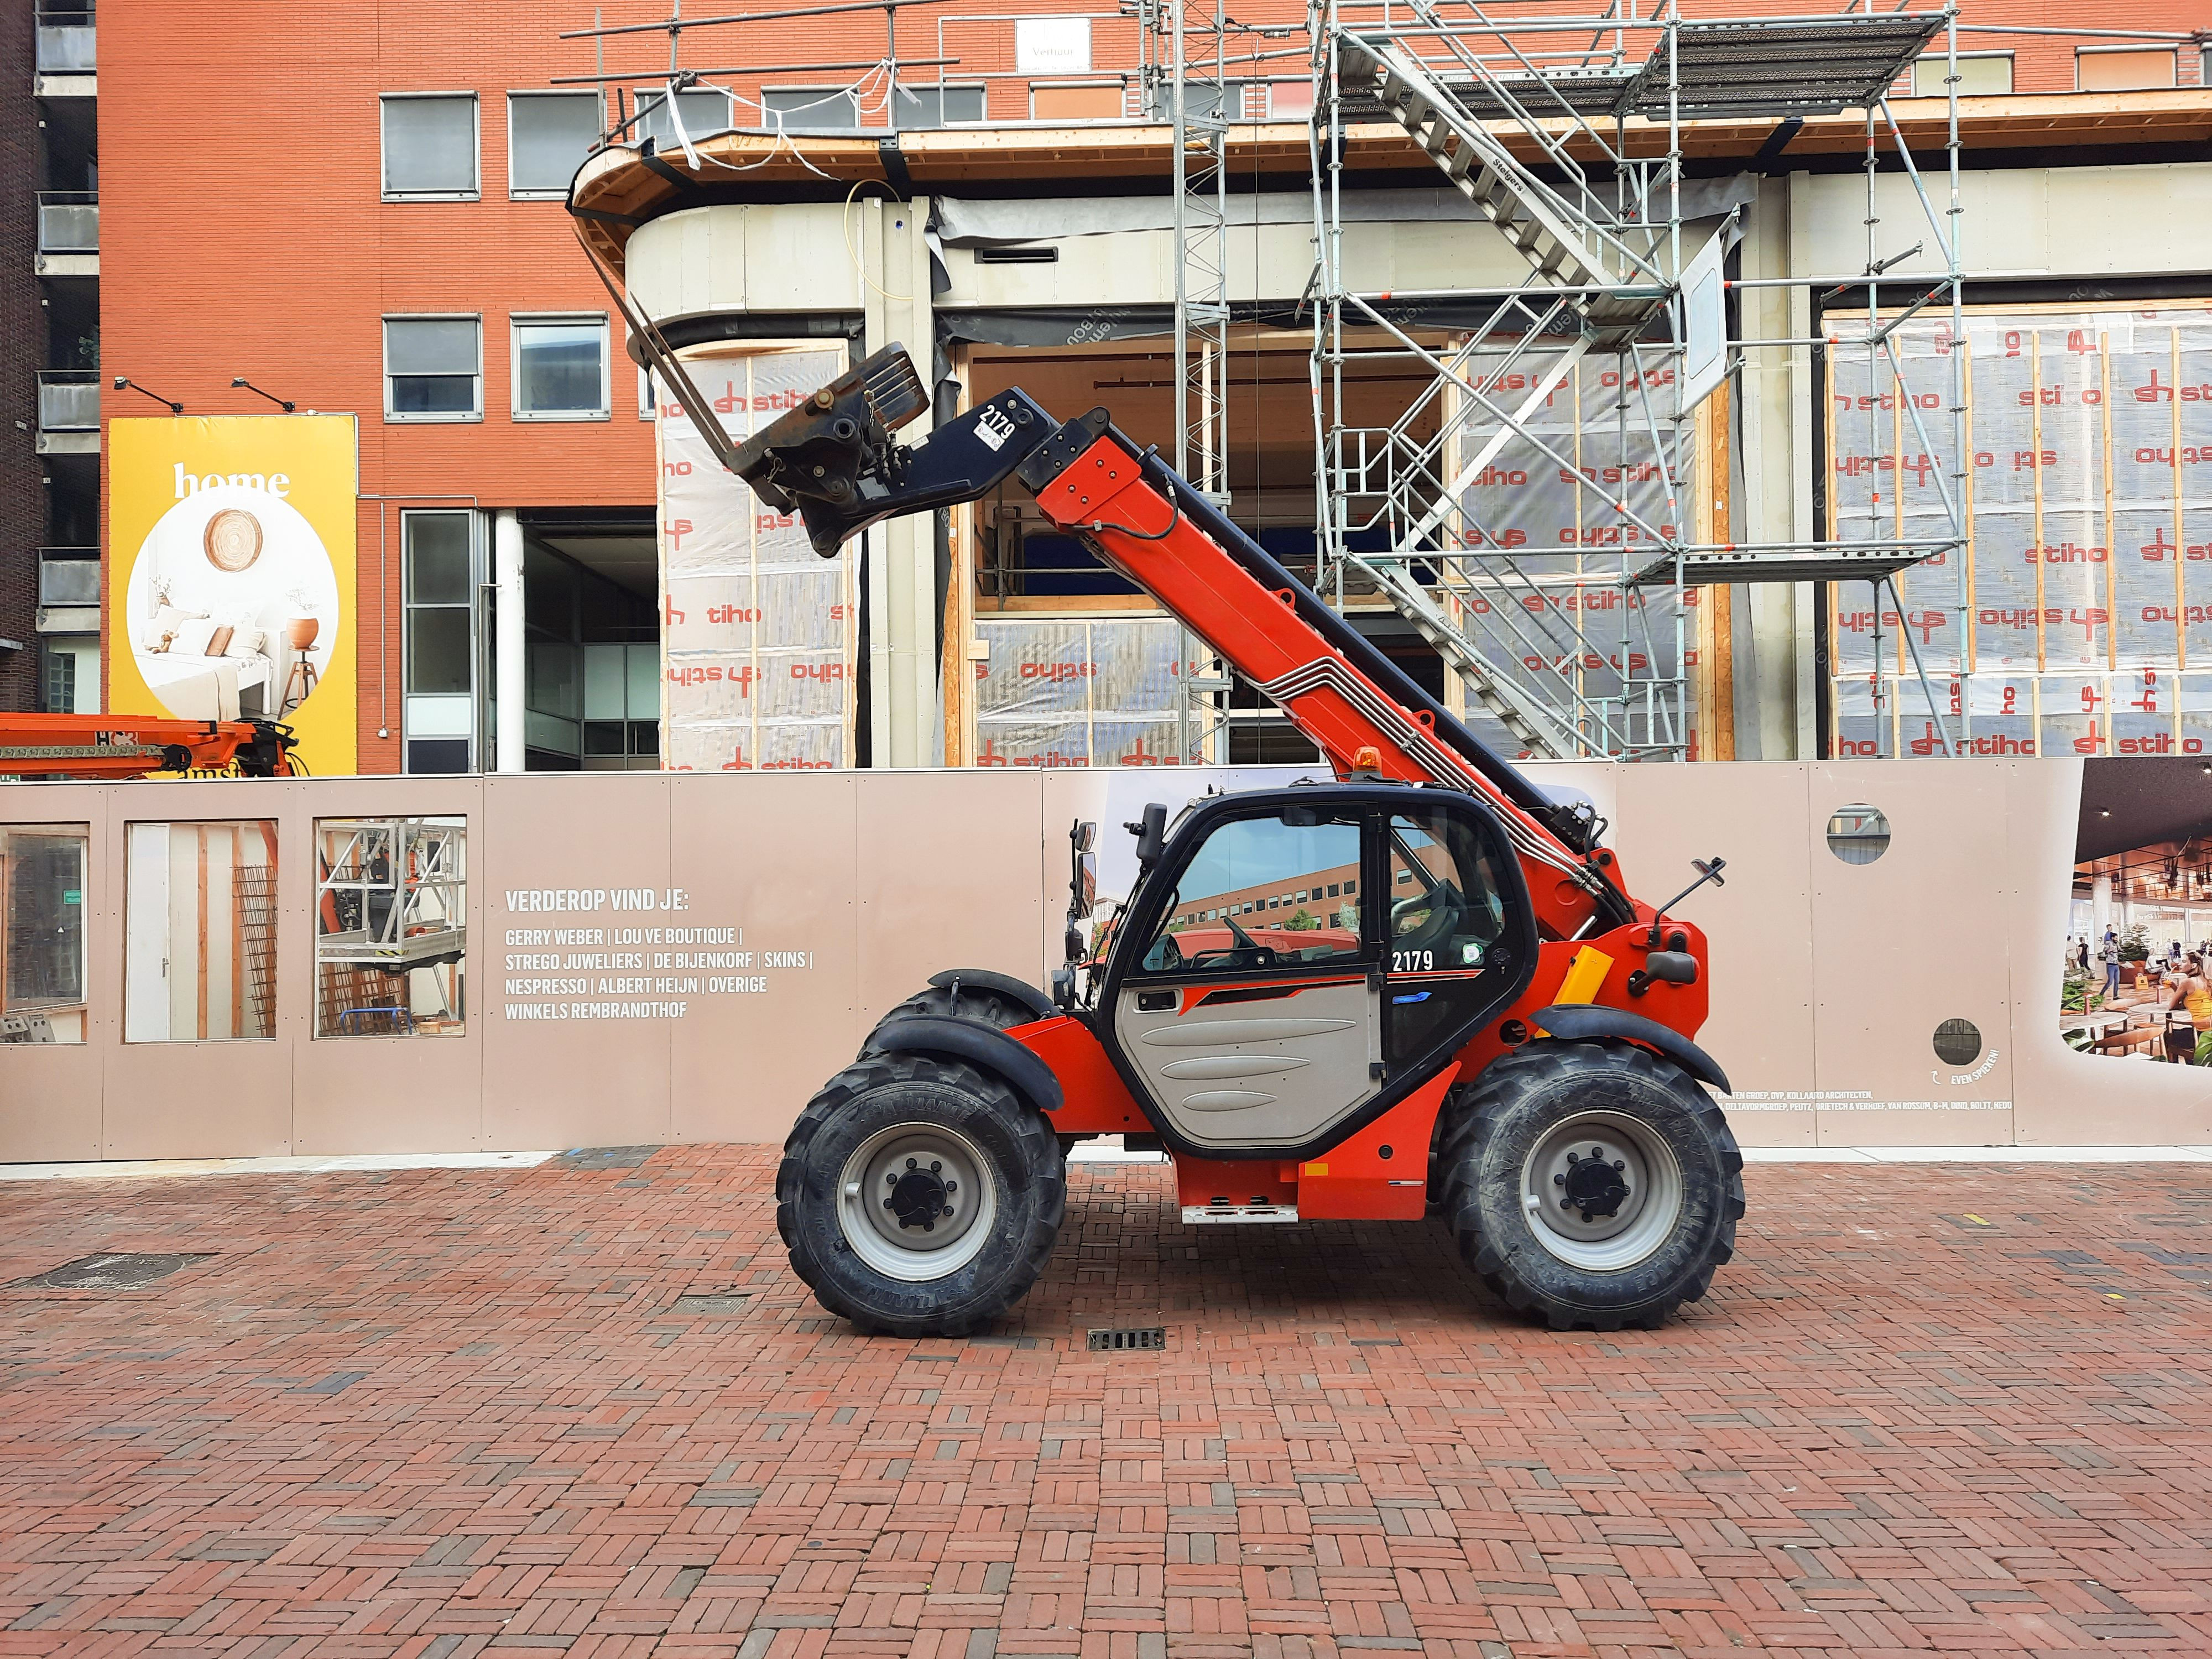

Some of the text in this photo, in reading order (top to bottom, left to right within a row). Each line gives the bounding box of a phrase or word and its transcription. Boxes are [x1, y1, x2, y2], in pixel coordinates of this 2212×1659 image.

[1493, 158, 1524, 192] Steigers
[979, 404, 1015, 440] 2179
[173, 462, 290, 498] home
[2025, 542, 2108, 564] stiho
[2119, 733, 2203, 754] stiho
[505, 889, 688, 912] VERDEROP VIND JE:
[505, 927, 735, 946] GERRY WEBER LOU VE BOUTIQUE
[505, 951, 806, 971] STREGO JUWELIERS DE BIJENKORF SKINS
[1392, 950, 1433, 972] 2179
[505, 977, 767, 995] NESPRESSO ALBERT HEIJN OVERIGE
[505, 1001, 687, 1020] WINKELS REMBRANDTHOF
[1951, 1073, 1973, 1084] EVEN
[1746, 1091, 1770, 1100] GROEP,
[1825, 1091, 1874, 1100] ARCHITECTEN,
[1790, 1102, 1814, 1112] PEUTZ,
[1849, 1102, 1855, 1111] &
[1887, 1102, 1902, 1110] VAN
